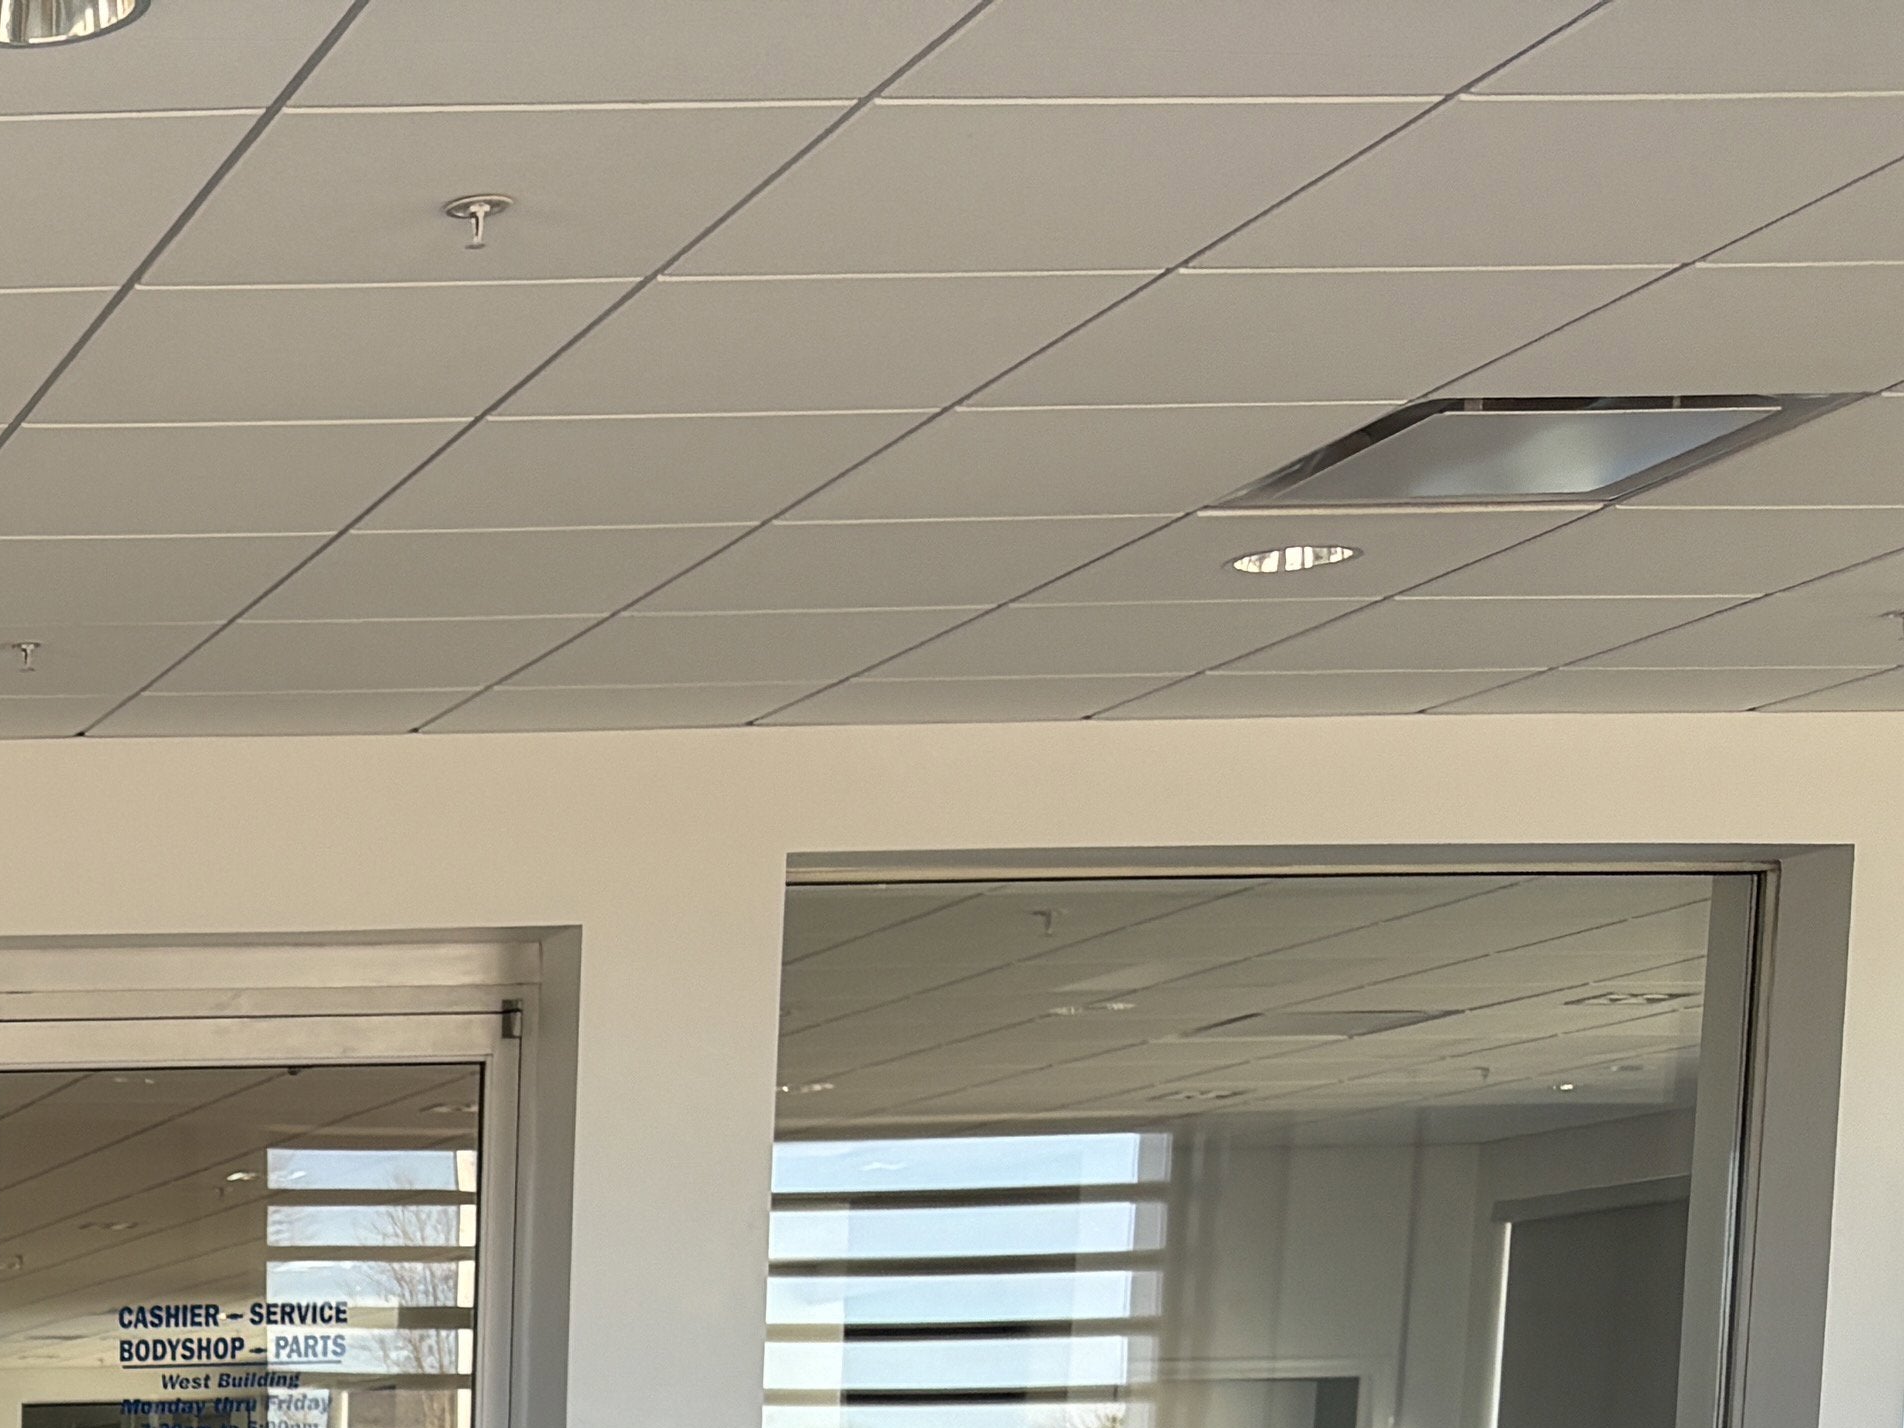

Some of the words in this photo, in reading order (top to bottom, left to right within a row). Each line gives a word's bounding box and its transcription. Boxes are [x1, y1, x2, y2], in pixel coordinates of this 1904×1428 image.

[118, 1304, 220, 1328] CASHIER
[249, 1301, 348, 1325] SERVICE
[119, 1337, 244, 1362] BODYSHOP
[274, 1334, 346, 1358] PARTS
[161, 1373, 211, 1390] West
[217, 1371, 300, 1389] Building
[121, 1398, 206, 1416] Monday
[213, 1396, 257, 1413] thru
[267, 1394, 332, 1414] Friday
